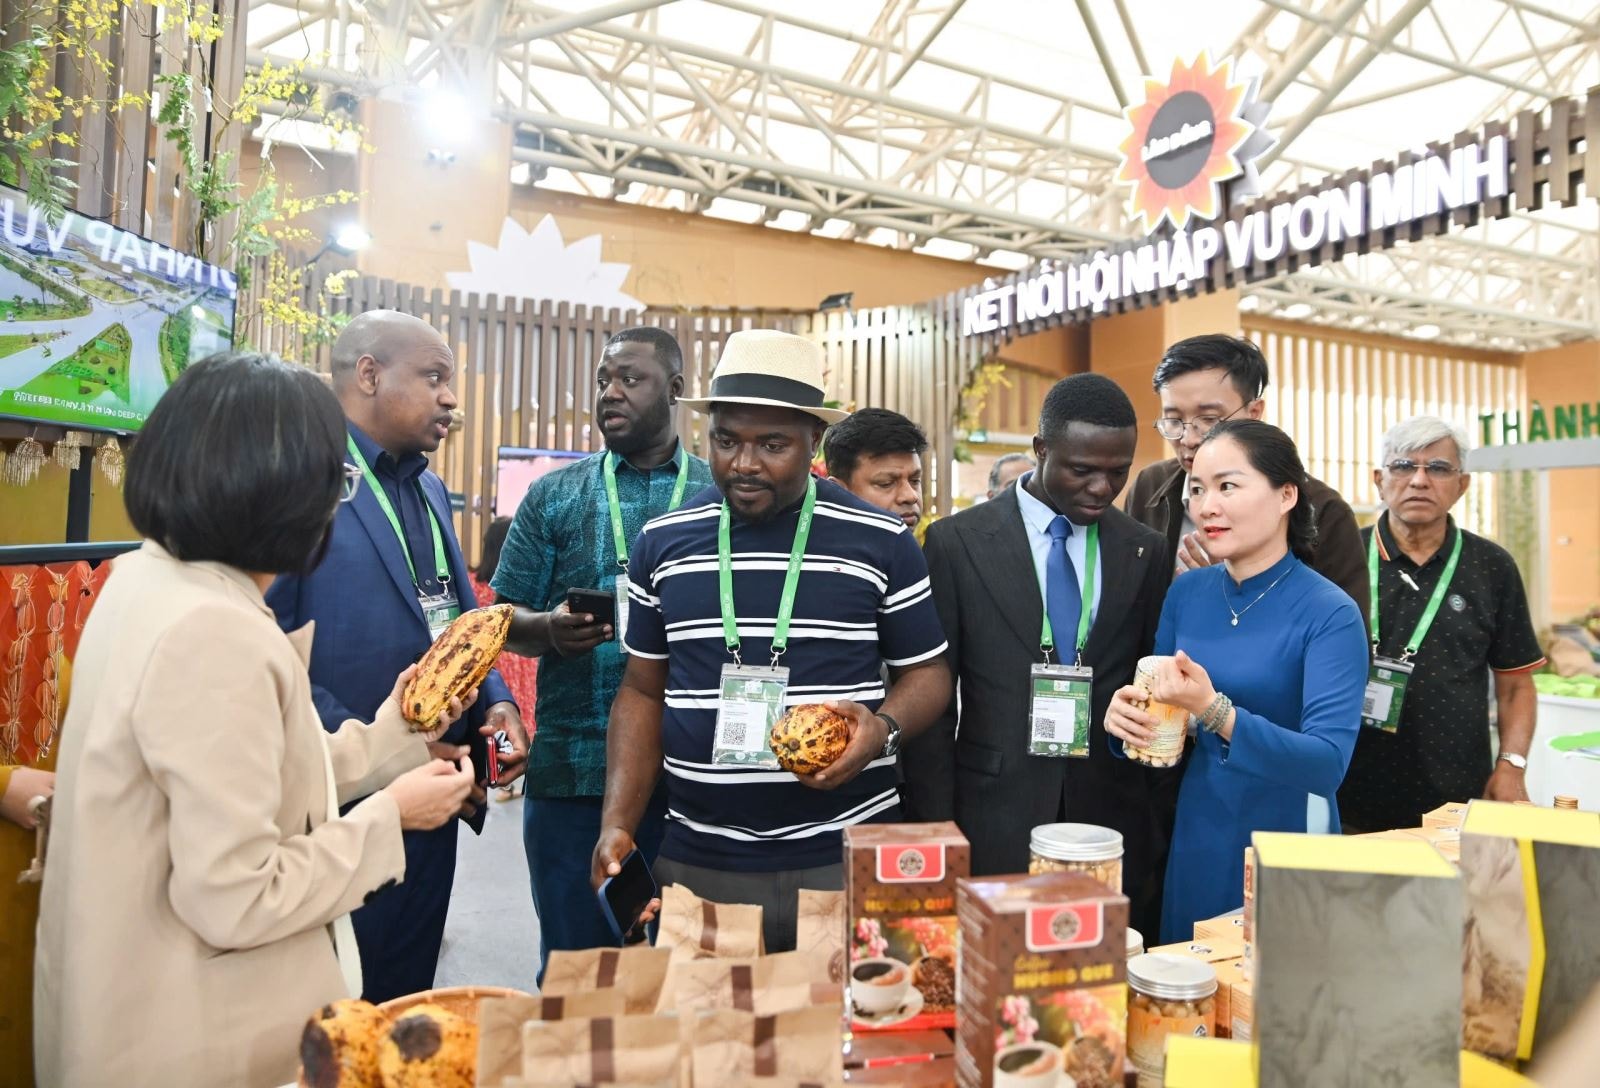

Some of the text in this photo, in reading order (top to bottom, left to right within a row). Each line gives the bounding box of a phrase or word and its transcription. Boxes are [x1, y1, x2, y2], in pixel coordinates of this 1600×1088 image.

[963, 277, 1015, 336] KẾT
[1017, 258, 1064, 323] NỐI
[1067, 250, 1119, 313] HỘI
[1122, 228, 1219, 296] NHẬP
[1224, 182, 1364, 269] VƯƠN
[1478, 400, 1600, 446] THÀNH
